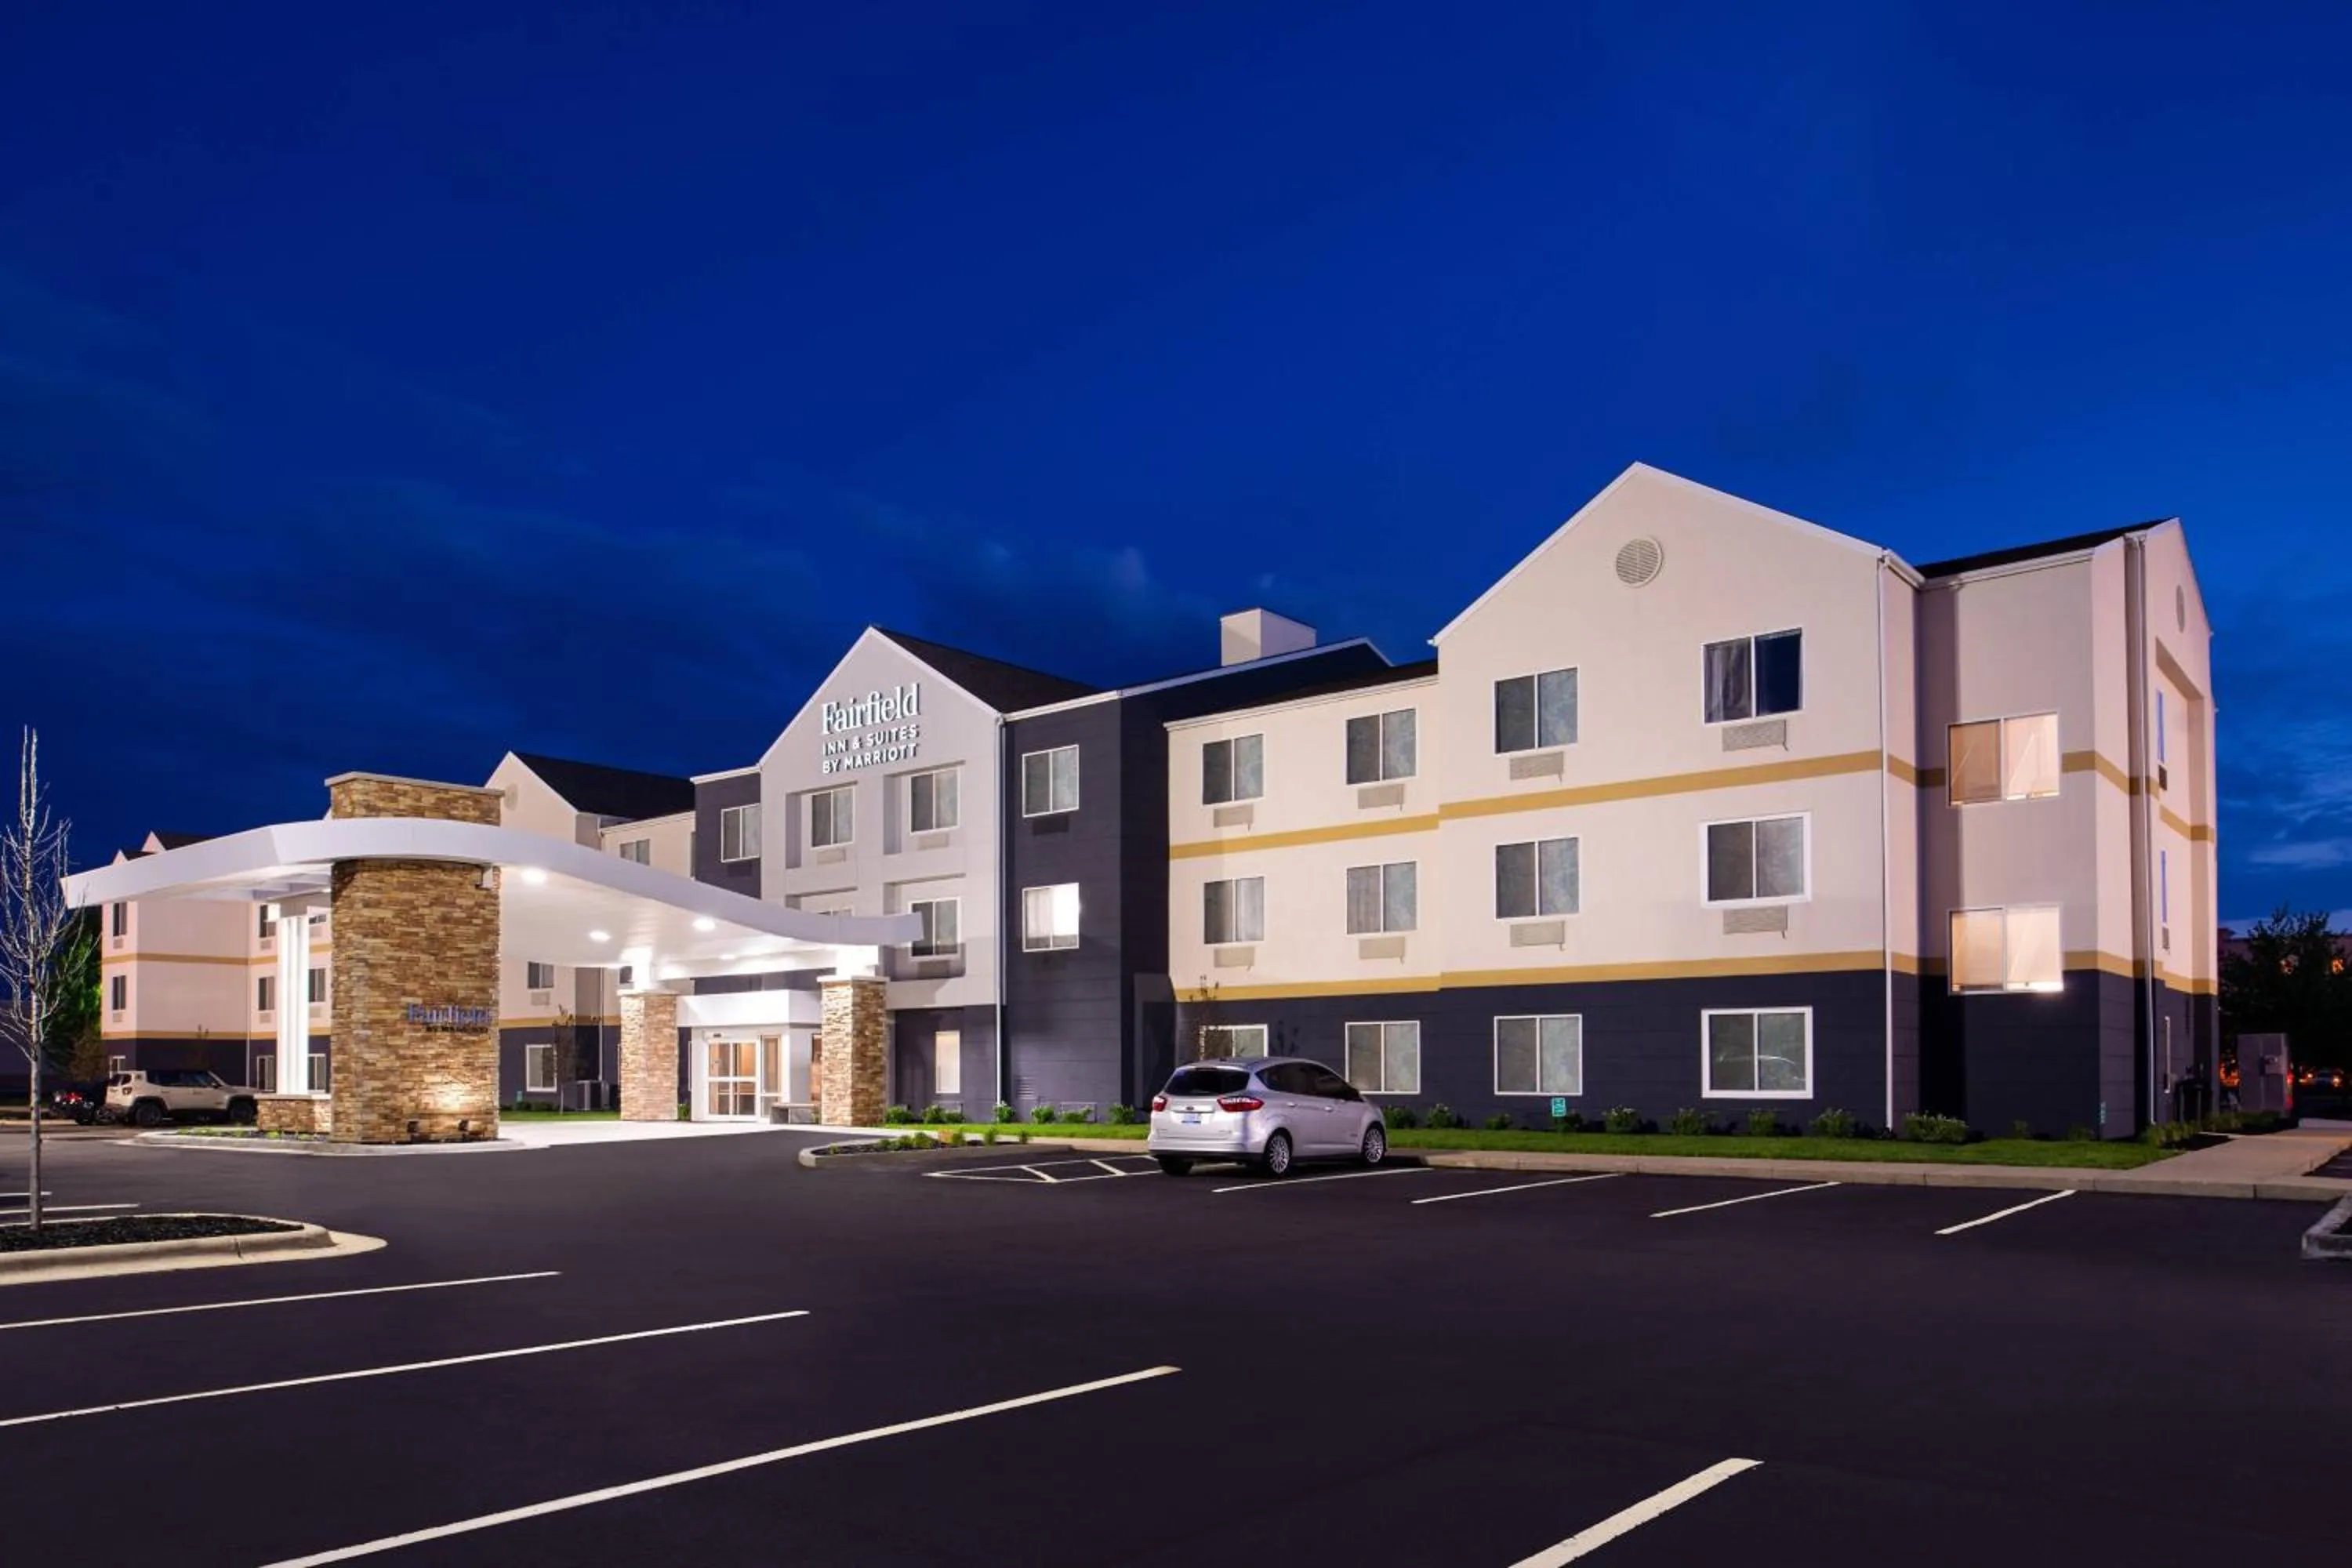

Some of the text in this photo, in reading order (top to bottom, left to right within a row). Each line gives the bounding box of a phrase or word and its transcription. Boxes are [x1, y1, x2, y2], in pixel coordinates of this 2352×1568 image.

[822, 683, 920, 735] Fairfield
[823, 724, 919, 757] INN & SUITES
[822, 742, 920, 774] BY MARRIOTT
